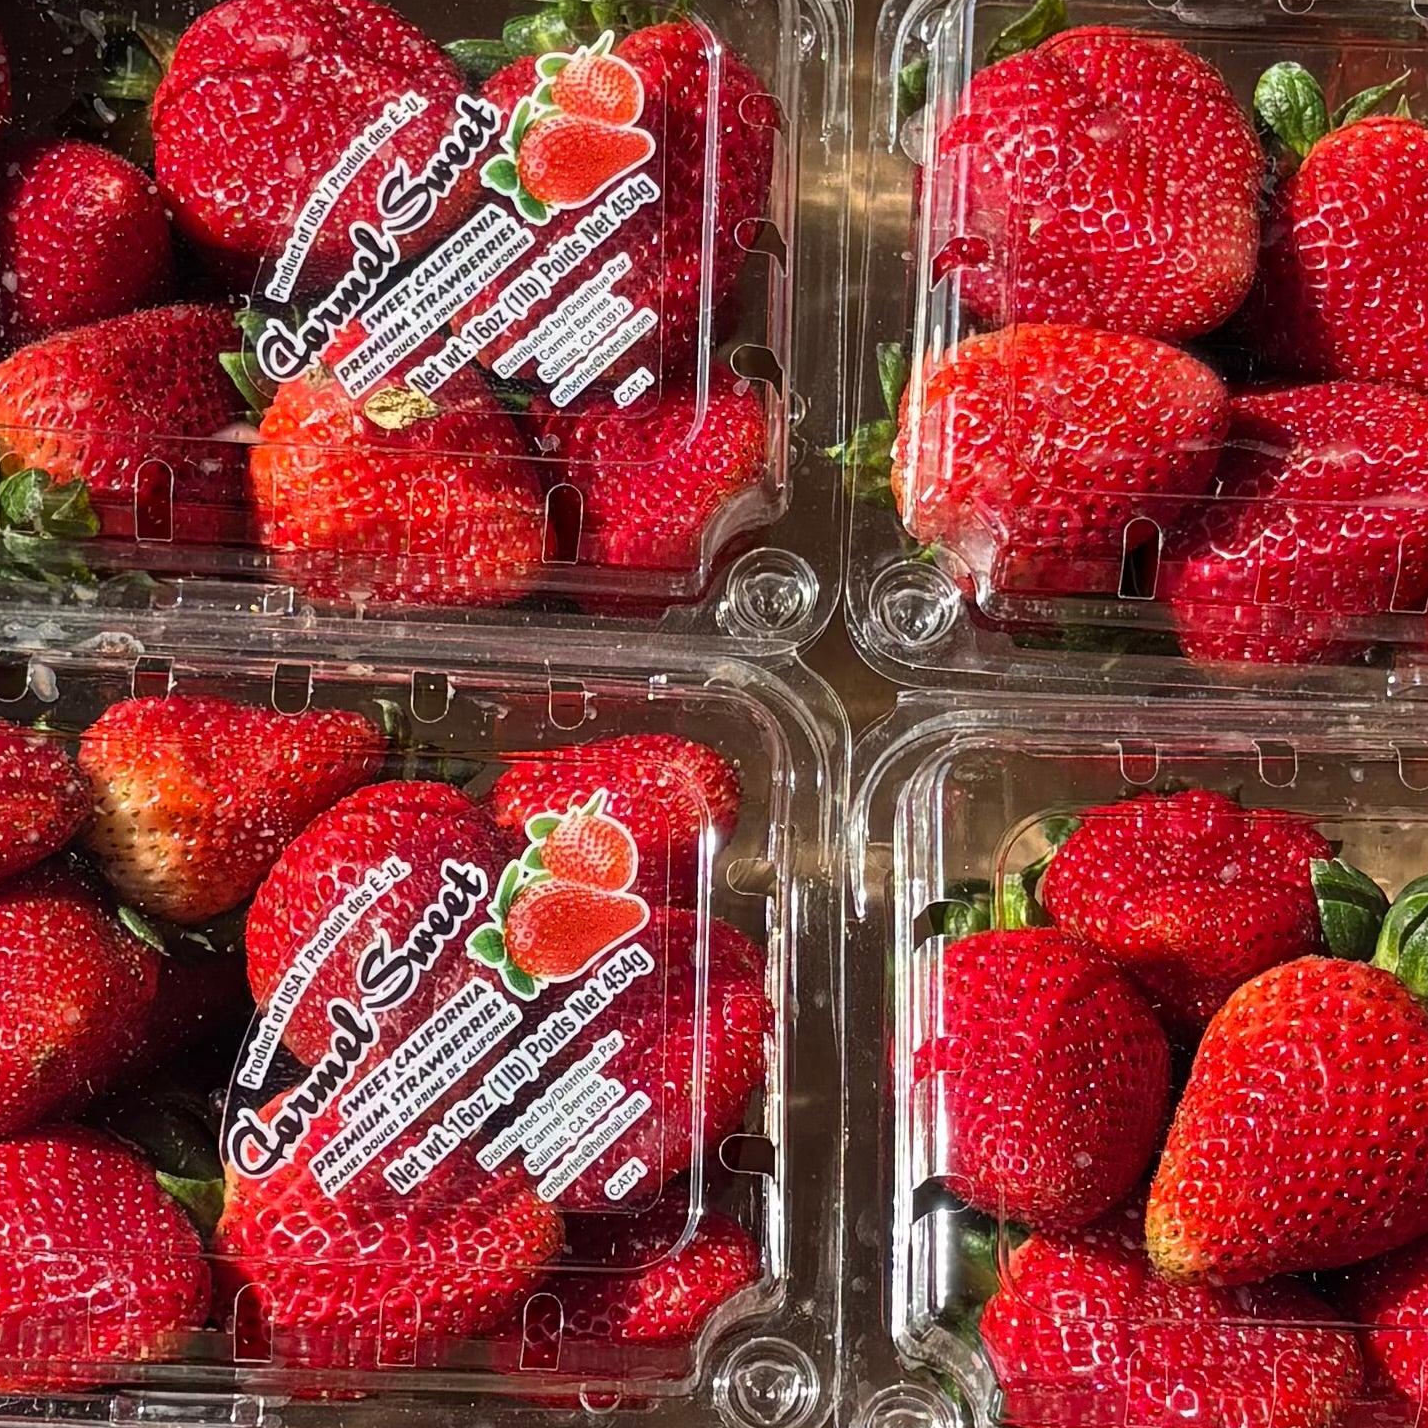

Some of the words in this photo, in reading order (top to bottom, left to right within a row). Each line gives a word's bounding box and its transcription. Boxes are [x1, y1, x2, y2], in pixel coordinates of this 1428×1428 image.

[262, 225, 396, 378] Carmel
[380, 100, 496, 230] Sweet
[338, 315, 412, 383] PREMIUM
[410, 222, 517, 320] STRAWBERRIES
[365, 283, 412, 331] SWEET
[414, 209, 503, 287] CALIFORNIA
[232, 1002, 375, 1174] Carmel
[360, 864, 482, 1007] Sweet
[312, 1102, 391, 1178] PREMIUM
[390, 997, 503, 1107] STRAWBERRIES
[341, 1066, 392, 1119] SWEET
[394, 983, 488, 1070] CALIFORNIA
[387, 1153, 427, 1191] Net
[420, 1131, 455, 1162] wt.
[447, 1092, 494, 1135] 16oz
[487, 1055, 534, 1102] (1lb)
[523, 1015, 577, 1064] Poids
[569, 984, 608, 1022] Net
[602, 949, 650, 992] 454g
